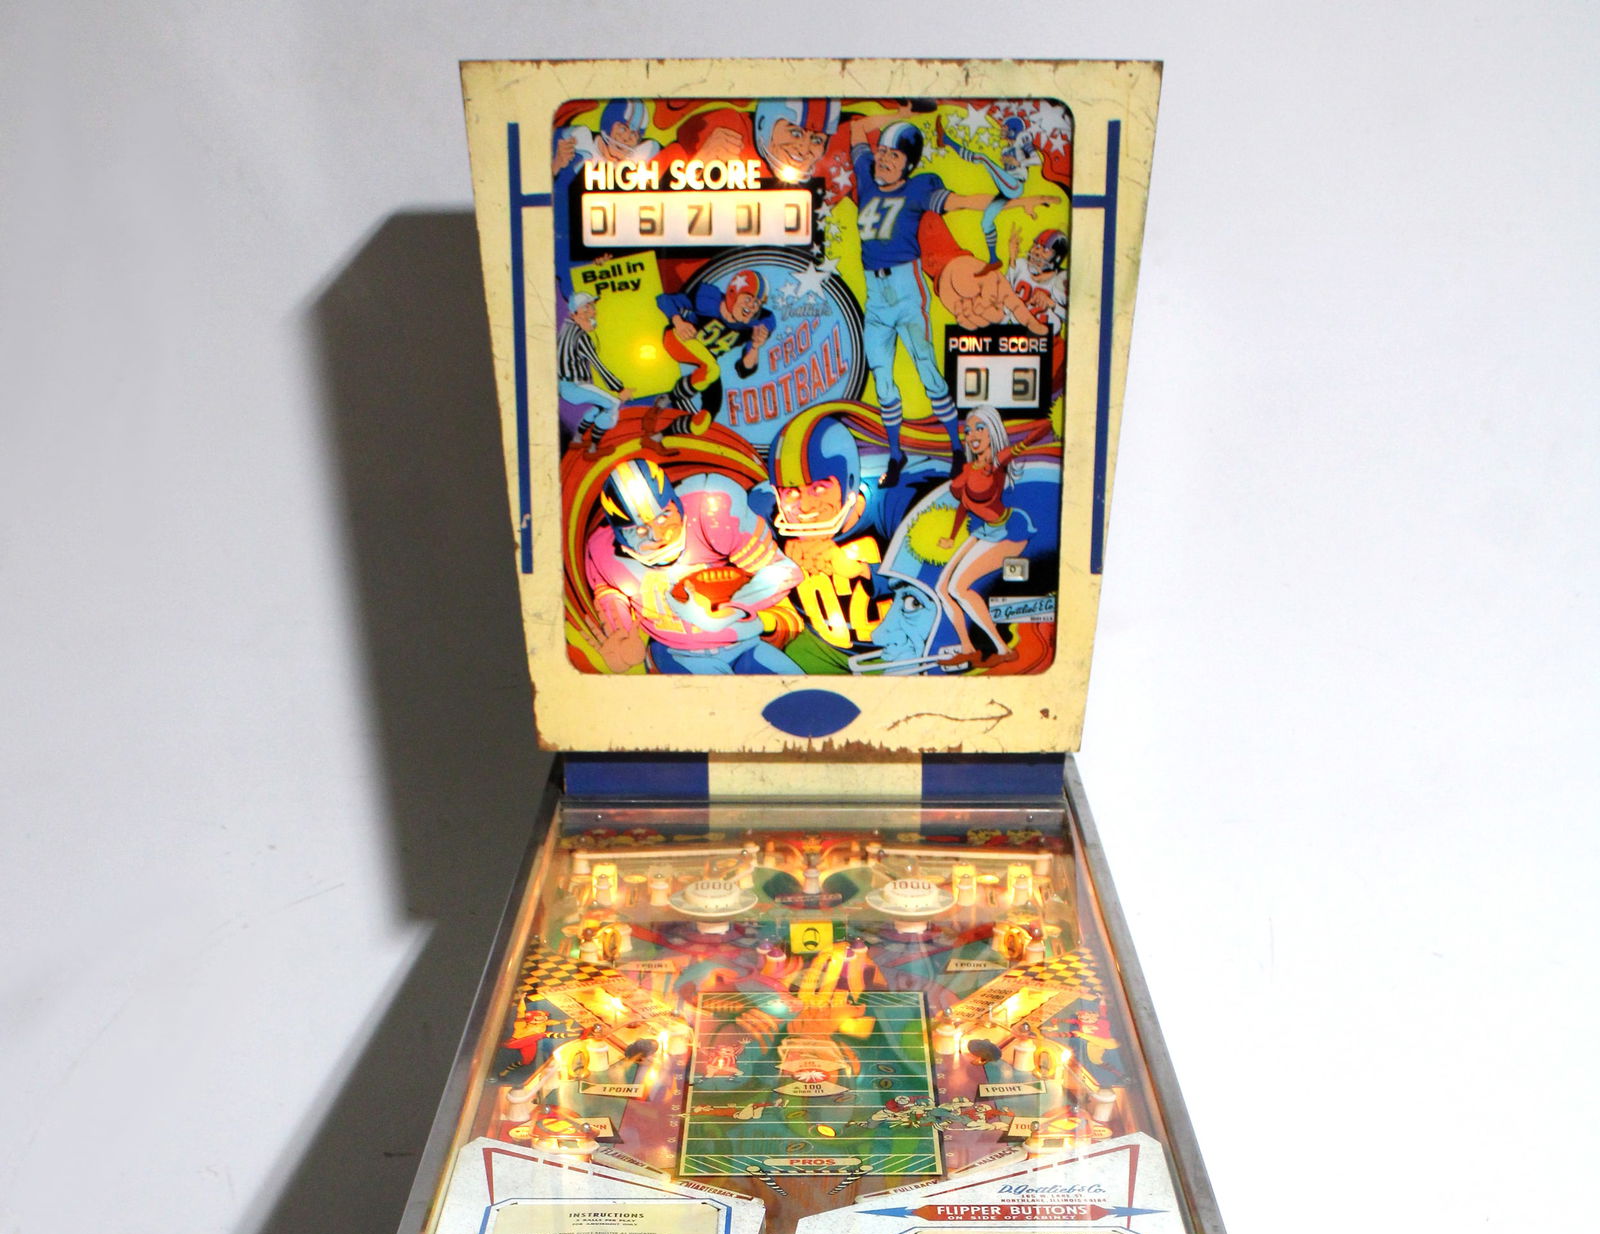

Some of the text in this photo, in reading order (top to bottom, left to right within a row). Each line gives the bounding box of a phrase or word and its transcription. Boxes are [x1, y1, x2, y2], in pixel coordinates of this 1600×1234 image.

[584, 159, 762, 191] HIGH SCORE
[857, 197, 905, 241] 47
[582, 262, 645, 283] Ball in
[594, 279, 642, 296] Play
[696, 319, 740, 355] 54
[948, 336, 1048, 353] POINT SCORE
[726, 322, 849, 427] FOOTBALL
[789, 1158, 836, 1166] PROS
[977, 1146, 1020, 1166] HALFBACK
[679, 1181, 735, 1197] QUARTERBACK
[892, 1179, 938, 1193] FULLBACK
[937, 1205, 1088, 1215] FLIPPER BUTTONS
